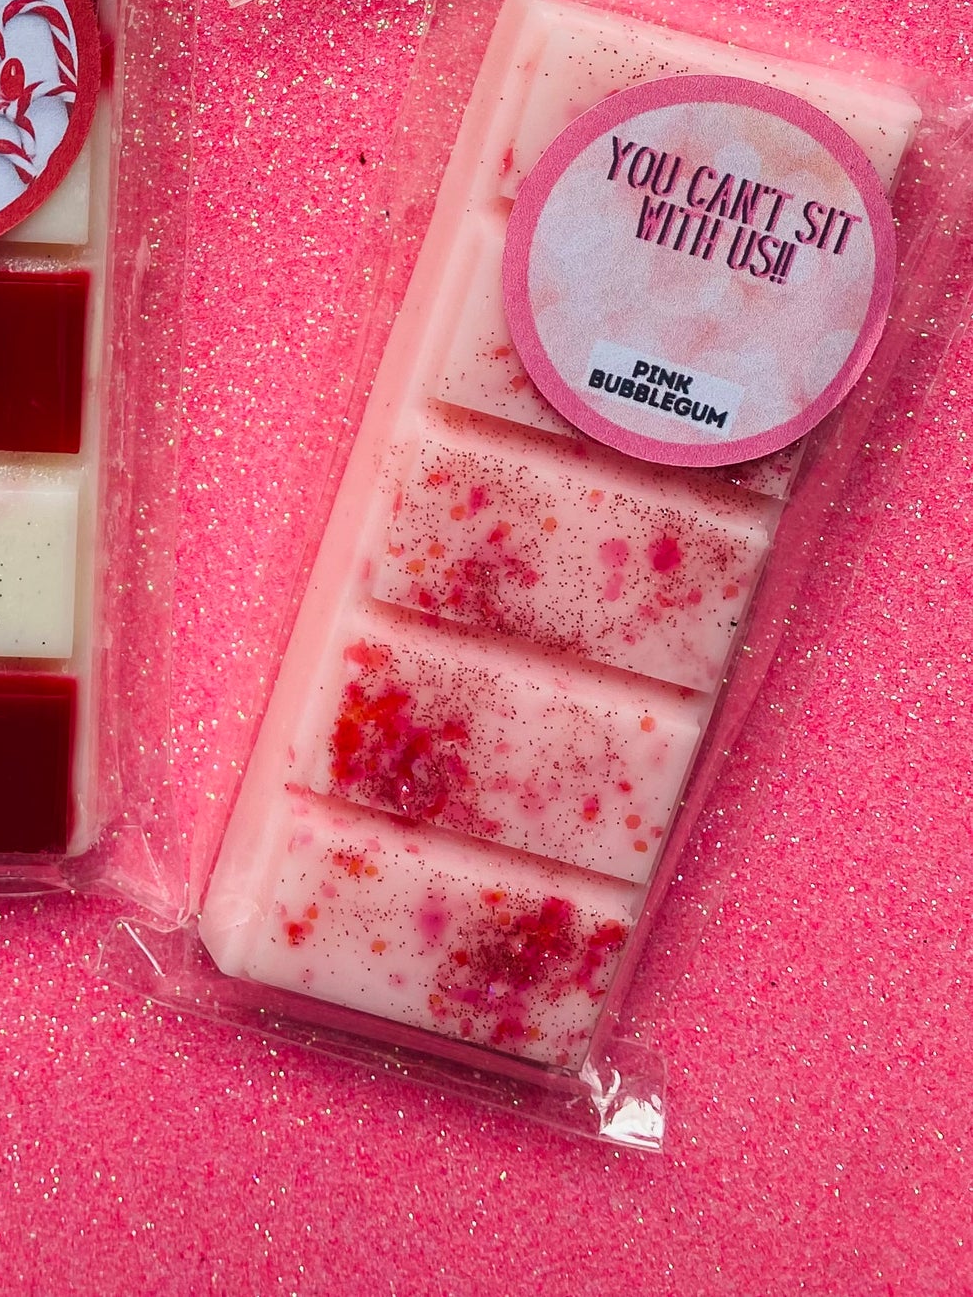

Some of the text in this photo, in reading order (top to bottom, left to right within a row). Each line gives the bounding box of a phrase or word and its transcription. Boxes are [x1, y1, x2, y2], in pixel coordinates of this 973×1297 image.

[606, 135, 863, 255] YOU CAN'T SIT
[635, 195, 798, 286] WITH US!!
[588, 369, 729, 430] BUBBLEGUM
[632, 360, 694, 394] PINK
